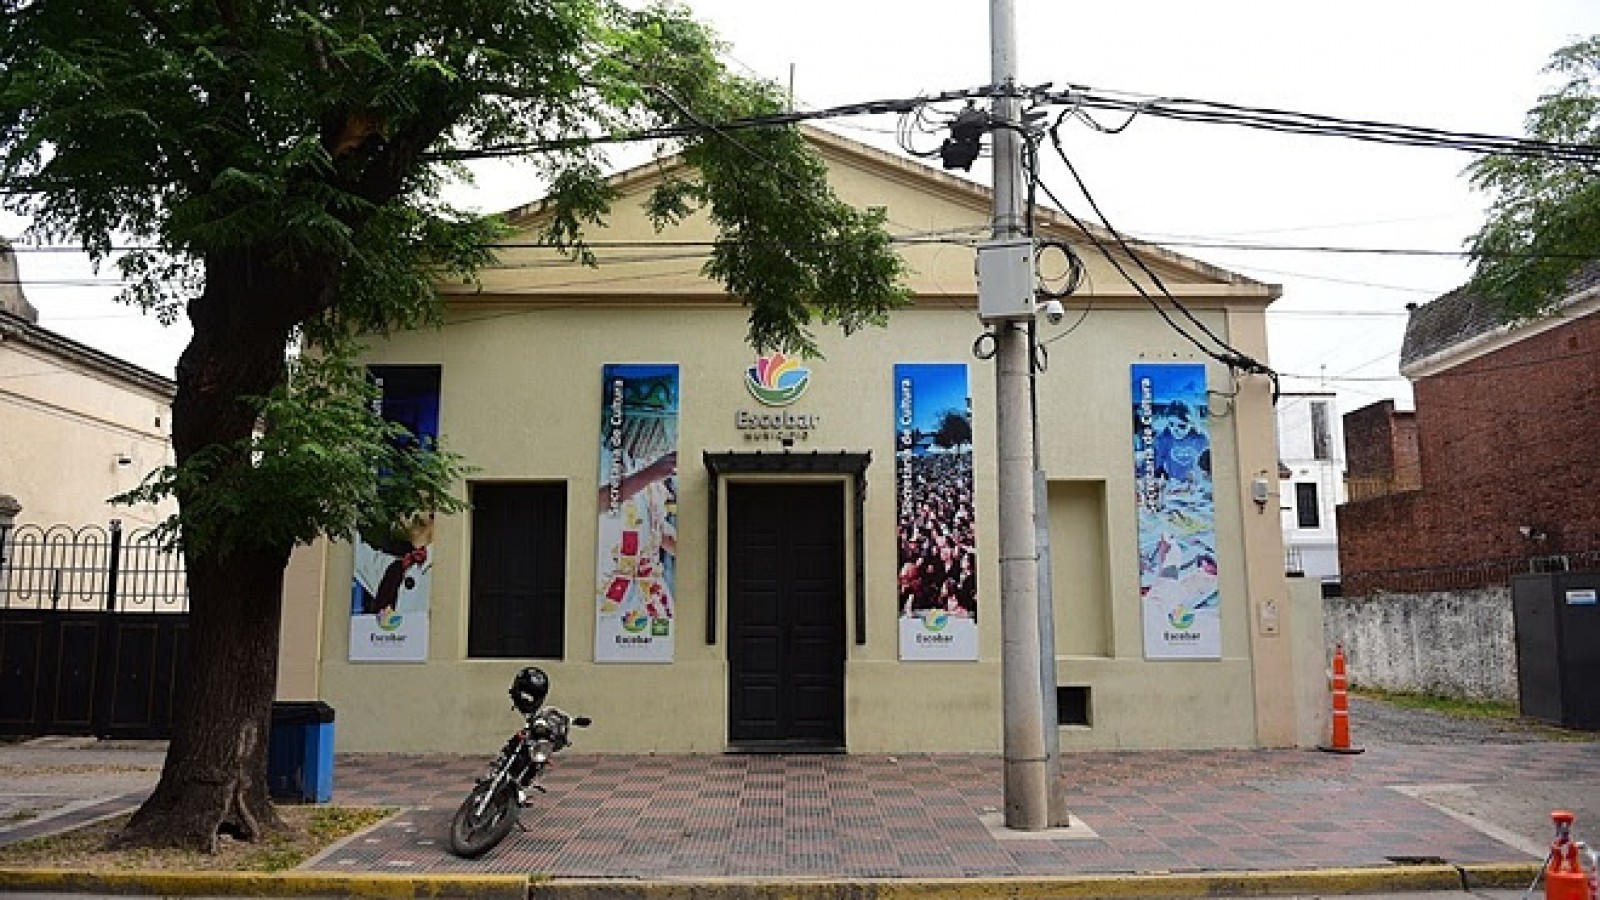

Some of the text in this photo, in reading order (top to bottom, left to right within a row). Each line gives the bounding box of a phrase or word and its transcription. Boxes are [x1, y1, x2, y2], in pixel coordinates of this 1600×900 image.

[610, 380, 622, 425] Cultura
[900, 380, 911, 425] Cultura
[1141, 379, 1152, 424] Cultura
[735, 410, 820, 429] Escobar
[370, 632, 407, 643] Escobar
[615, 634, 652, 644] Escobar
[915, 632, 953, 644] Escobar
[1163, 631, 1201, 641] Escobar
